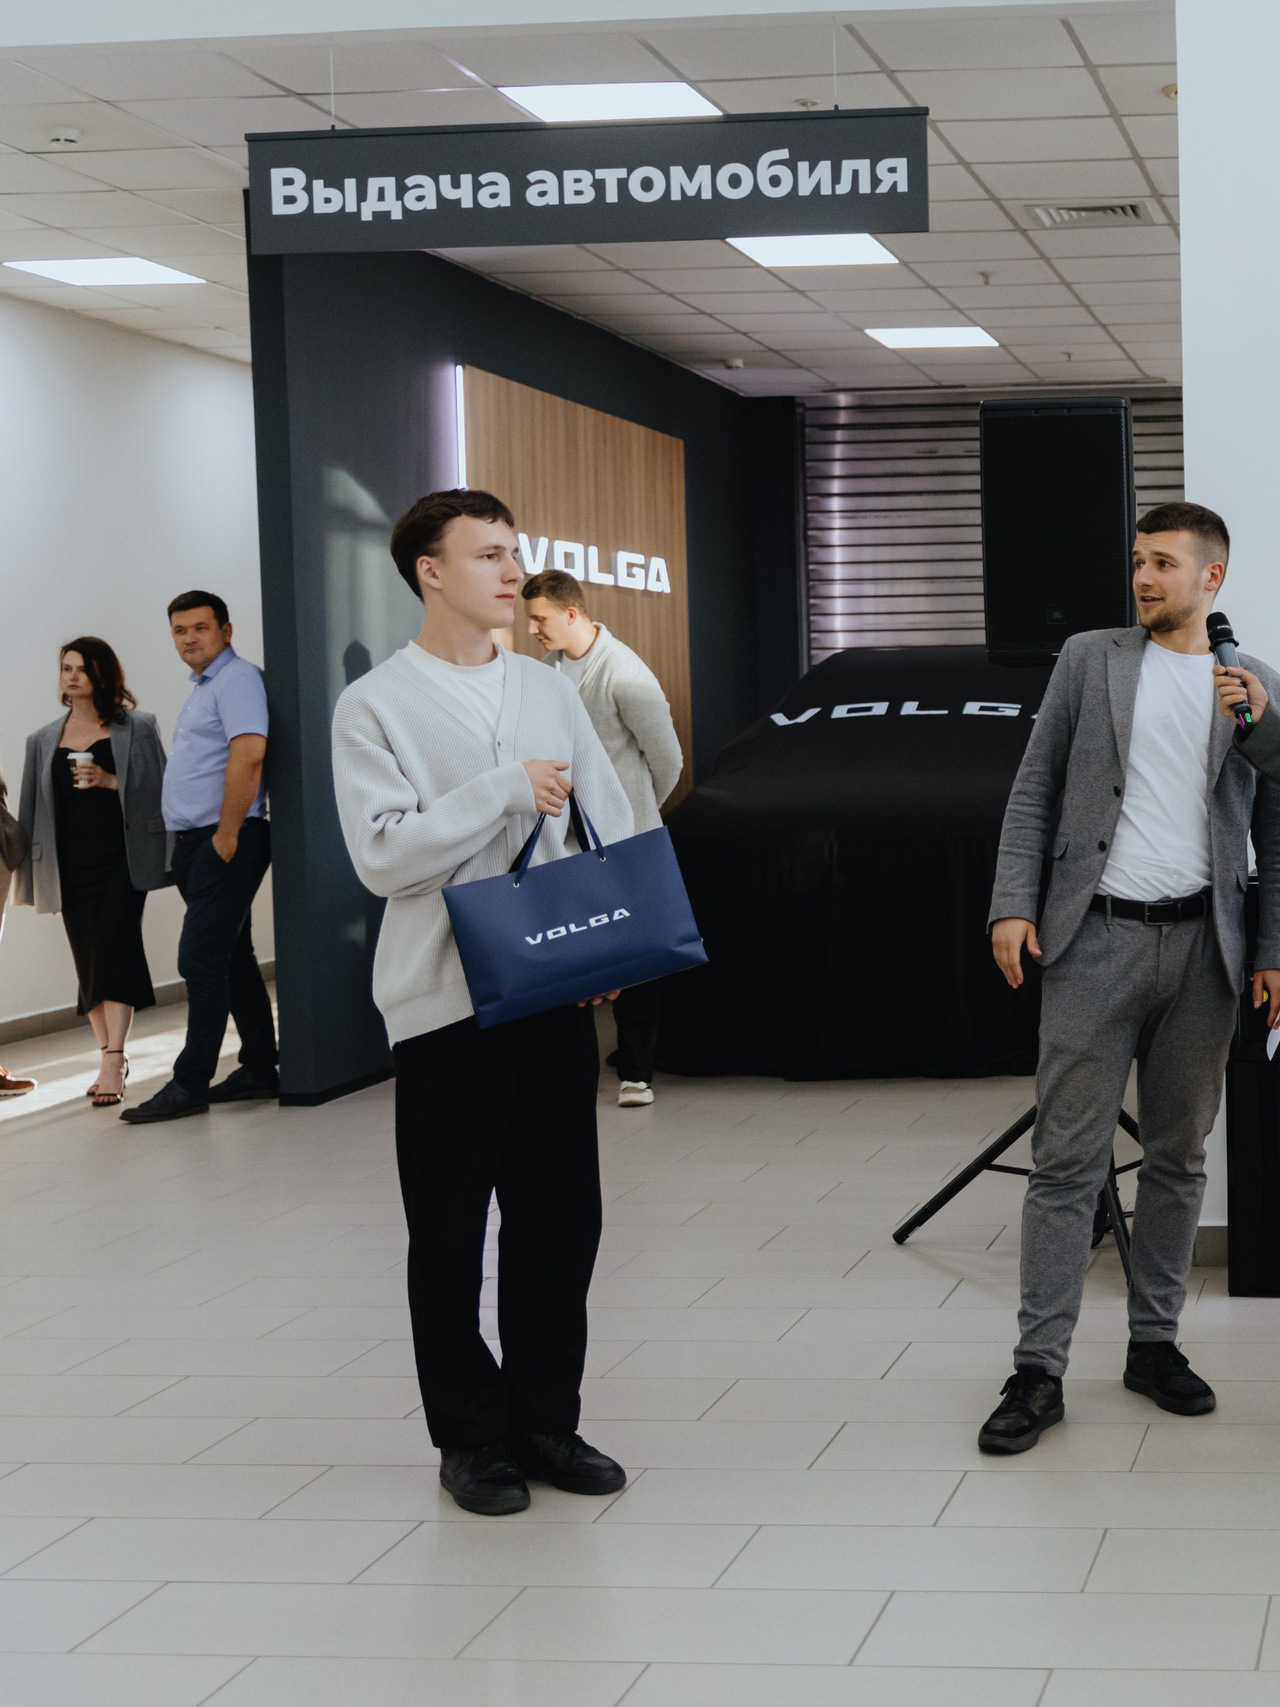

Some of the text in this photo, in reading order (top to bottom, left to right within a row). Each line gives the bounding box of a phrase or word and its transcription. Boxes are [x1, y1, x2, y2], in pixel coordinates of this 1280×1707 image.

[270, 149, 909, 222] Выдача автомобиля
[517, 532, 671, 593] VOLGA
[770, 701, 1039, 726] VOLG
[525, 908, 631, 945] VOLGA
